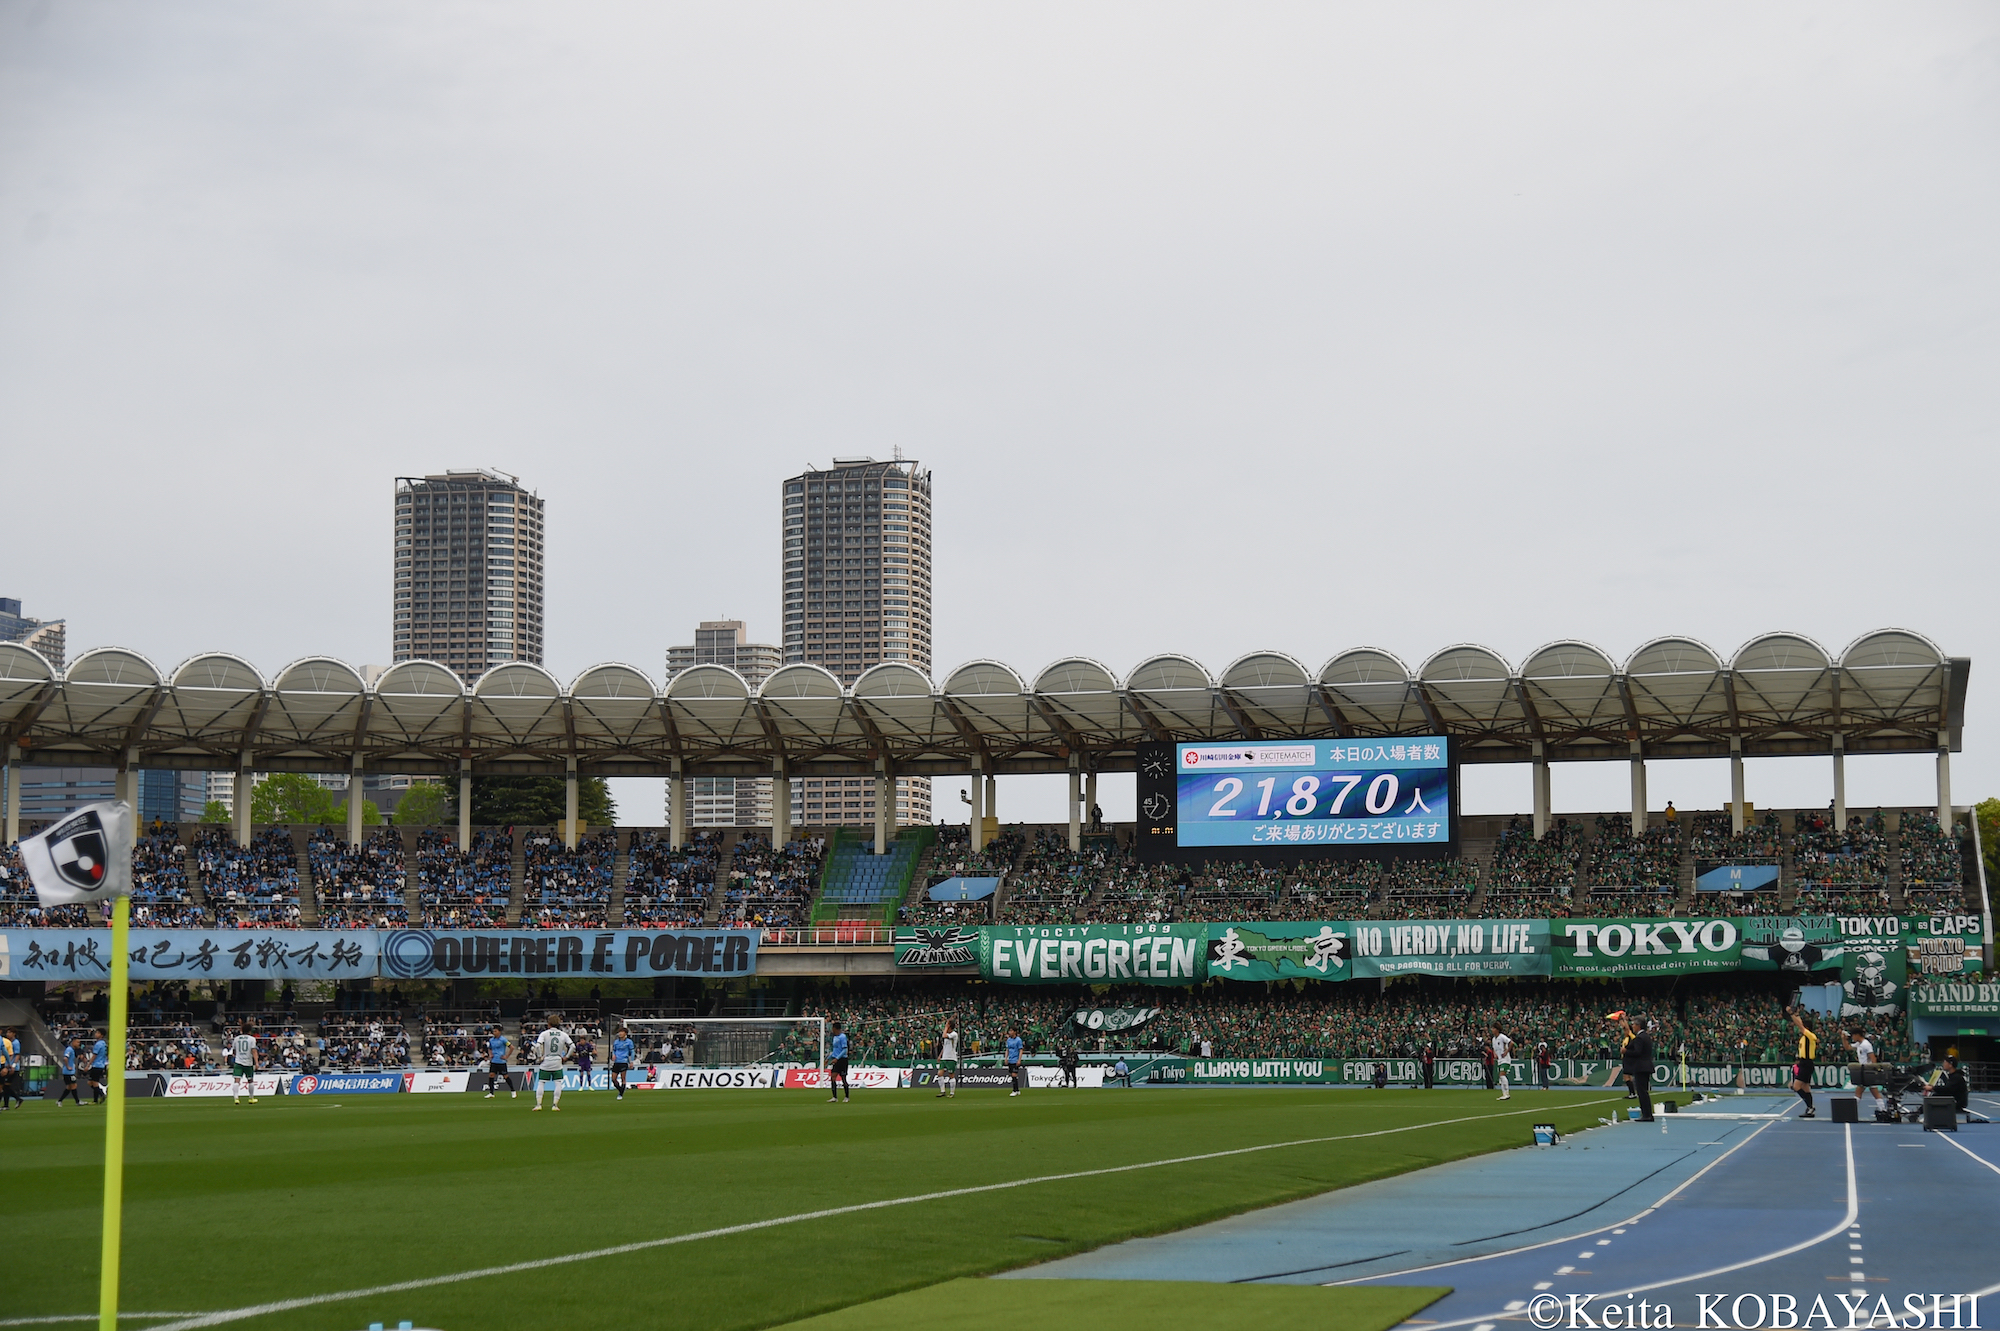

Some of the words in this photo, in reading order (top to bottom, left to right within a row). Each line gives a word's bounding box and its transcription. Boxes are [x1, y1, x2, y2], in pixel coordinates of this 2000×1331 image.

[1260, 751, 1311, 759] EXCITEMATCH
[1330, 745, 1441, 761] 本日の入場者数
[1207, 774, 1399, 821] 21,870
[1251, 823, 1441, 843] ご来場ありがとうございます
[1730, 868, 1742, 879] M
[961, 880, 967, 890] L
[1014, 926, 1090, 938] TYOCTY
[1122, 924, 1171, 935] 1969
[1749, 918, 1834, 930] GREENIZE
[1836, 916, 1899, 936] TOKYO
[1901, 921, 1909, 930] 19
[1918, 921, 1928, 930] 69
[1929, 915, 1980, 935] CAPS
[1356, 927, 1382, 956] NO
[1491, 924, 1535, 954] LIFE.
[1565, 919, 1737, 957] TOKYO
[1917, 937, 1965, 954] TOKYO
[433, 935, 583, 976] QUERER
[625, 933, 750, 972] PODER
[897, 946, 975, 965] IDENTITY
[1288, 944, 1308, 952] LABEL
[992, 936, 1197, 979] EVERGREEN
[1921, 954, 1964, 974] PRIDE
[1379, 964, 1395, 972] OUR
[1397, 962, 1433, 971] PASSION
[1434, 962, 1444, 971] IS
[1446, 962, 1462, 971] ALL
[1465, 962, 1481, 970] FOR
[1483, 960, 1512, 970] VERDY.
[1601, 962, 1667, 973] sophisticated
[1669, 960, 1686, 970] city
[1690, 959, 1700, 967] in
[1703, 959, 1719, 967] the
[1918, 984, 1975, 1003] STAND
[1978, 984, 2000, 1003] BY
[1964, 1004, 1998, 1012] PEAK'D
[238, 1040, 249, 1052] 10
[550, 1036, 560, 1053] 6
[851, 1072, 890, 1081] エバラ
[1150, 1066, 1159, 1079] in
[1161, 1065, 1185, 1081] Tokyo
[1193, 1061, 1249, 1078] ALWAYS
[1253, 1061, 1290, 1077] WITH
[1294, 1061, 1323, 1077] YOU
[1343, 1061, 1416, 1081] FAMLIA
[1439, 1061, 1486, 1080] VERD
[197, 1081, 276, 1091] アルファスムズ
[317, 1078, 394, 1090] 川崎信用金庫
[670, 1073, 761, 1088] RENOSY
[958, 1074, 1014, 1085] Technologie
